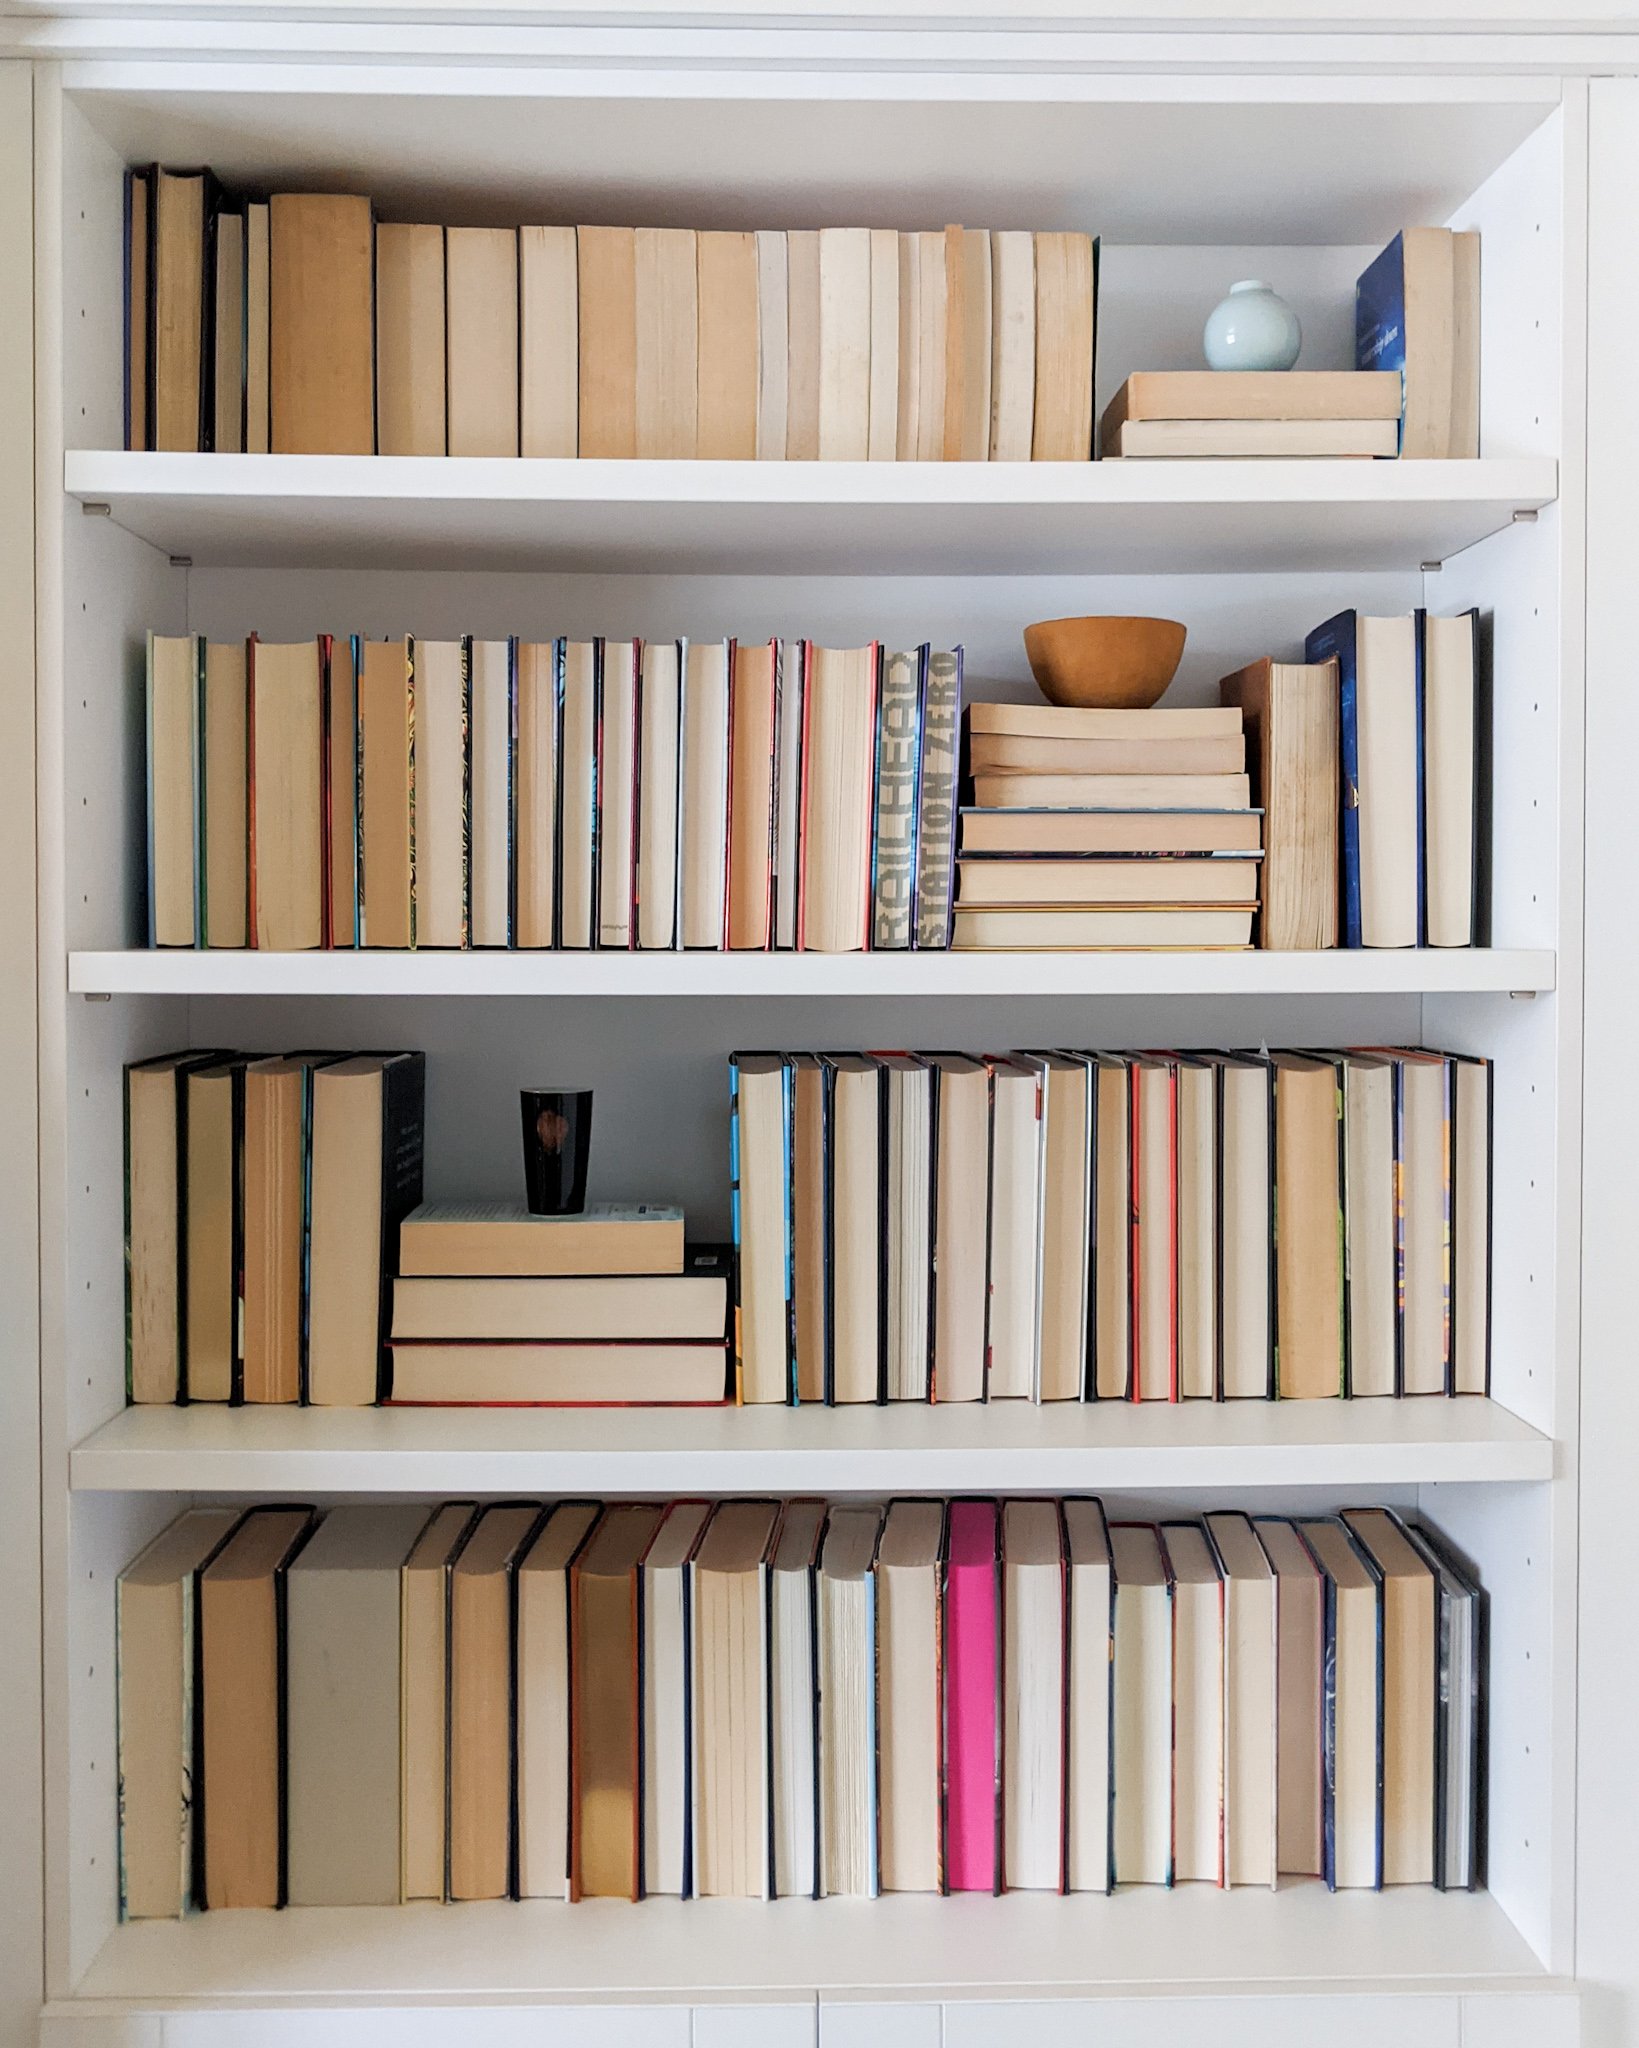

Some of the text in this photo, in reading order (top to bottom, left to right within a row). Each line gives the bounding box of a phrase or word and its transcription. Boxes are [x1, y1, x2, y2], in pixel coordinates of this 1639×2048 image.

[875, 652, 918, 948] RAILHEAD
[919, 652, 957, 948] STATION ZERO
